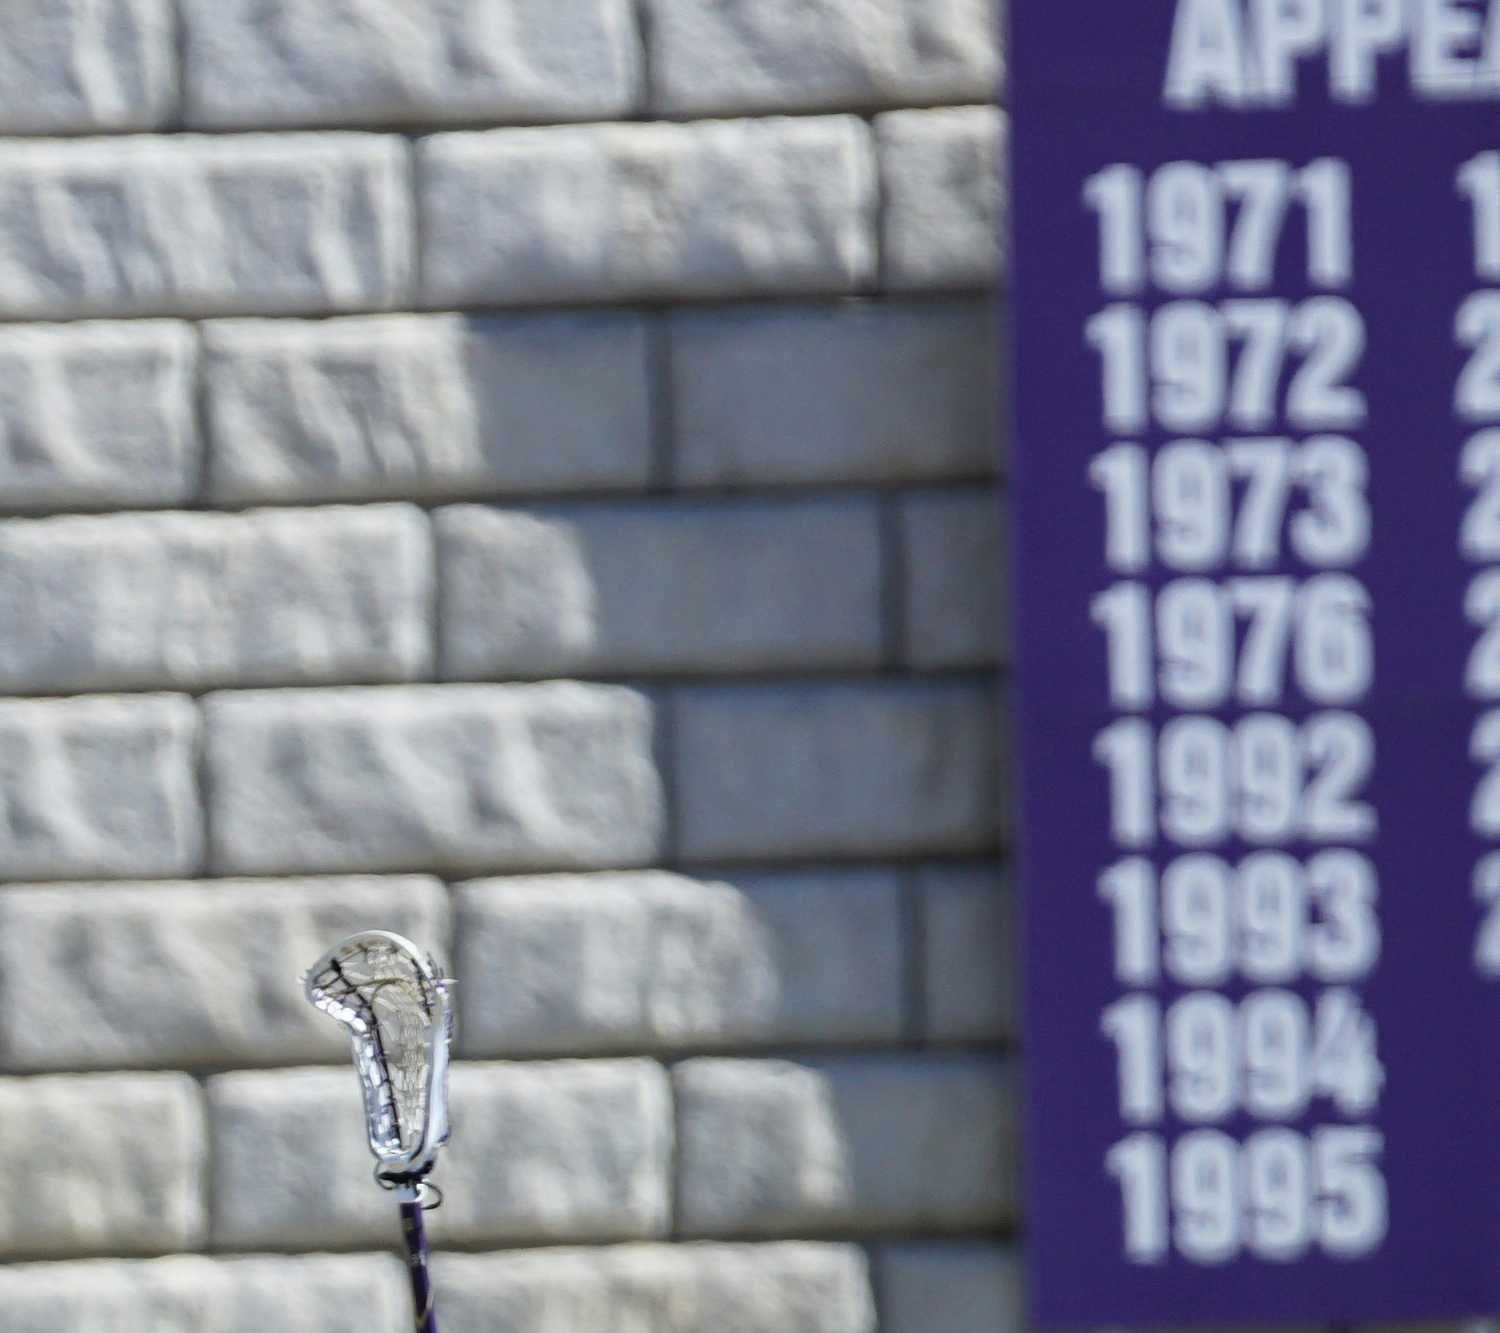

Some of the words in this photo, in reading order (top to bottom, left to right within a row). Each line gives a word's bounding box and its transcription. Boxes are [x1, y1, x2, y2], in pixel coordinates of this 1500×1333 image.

[1165, 0, 1500, 106] APPE
[1086, 158, 1350, 292] 1971
[1088, 297, 1364, 431] 1972
[1091, 436, 1370, 571] 1973
[1093, 574, 1372, 708] 1976
[1096, 712, 1374, 845] 1992
[1100, 850, 1378, 984] 1993
[1104, 988, 1383, 1122] 1994
[1108, 1126, 1386, 1260] 1995
